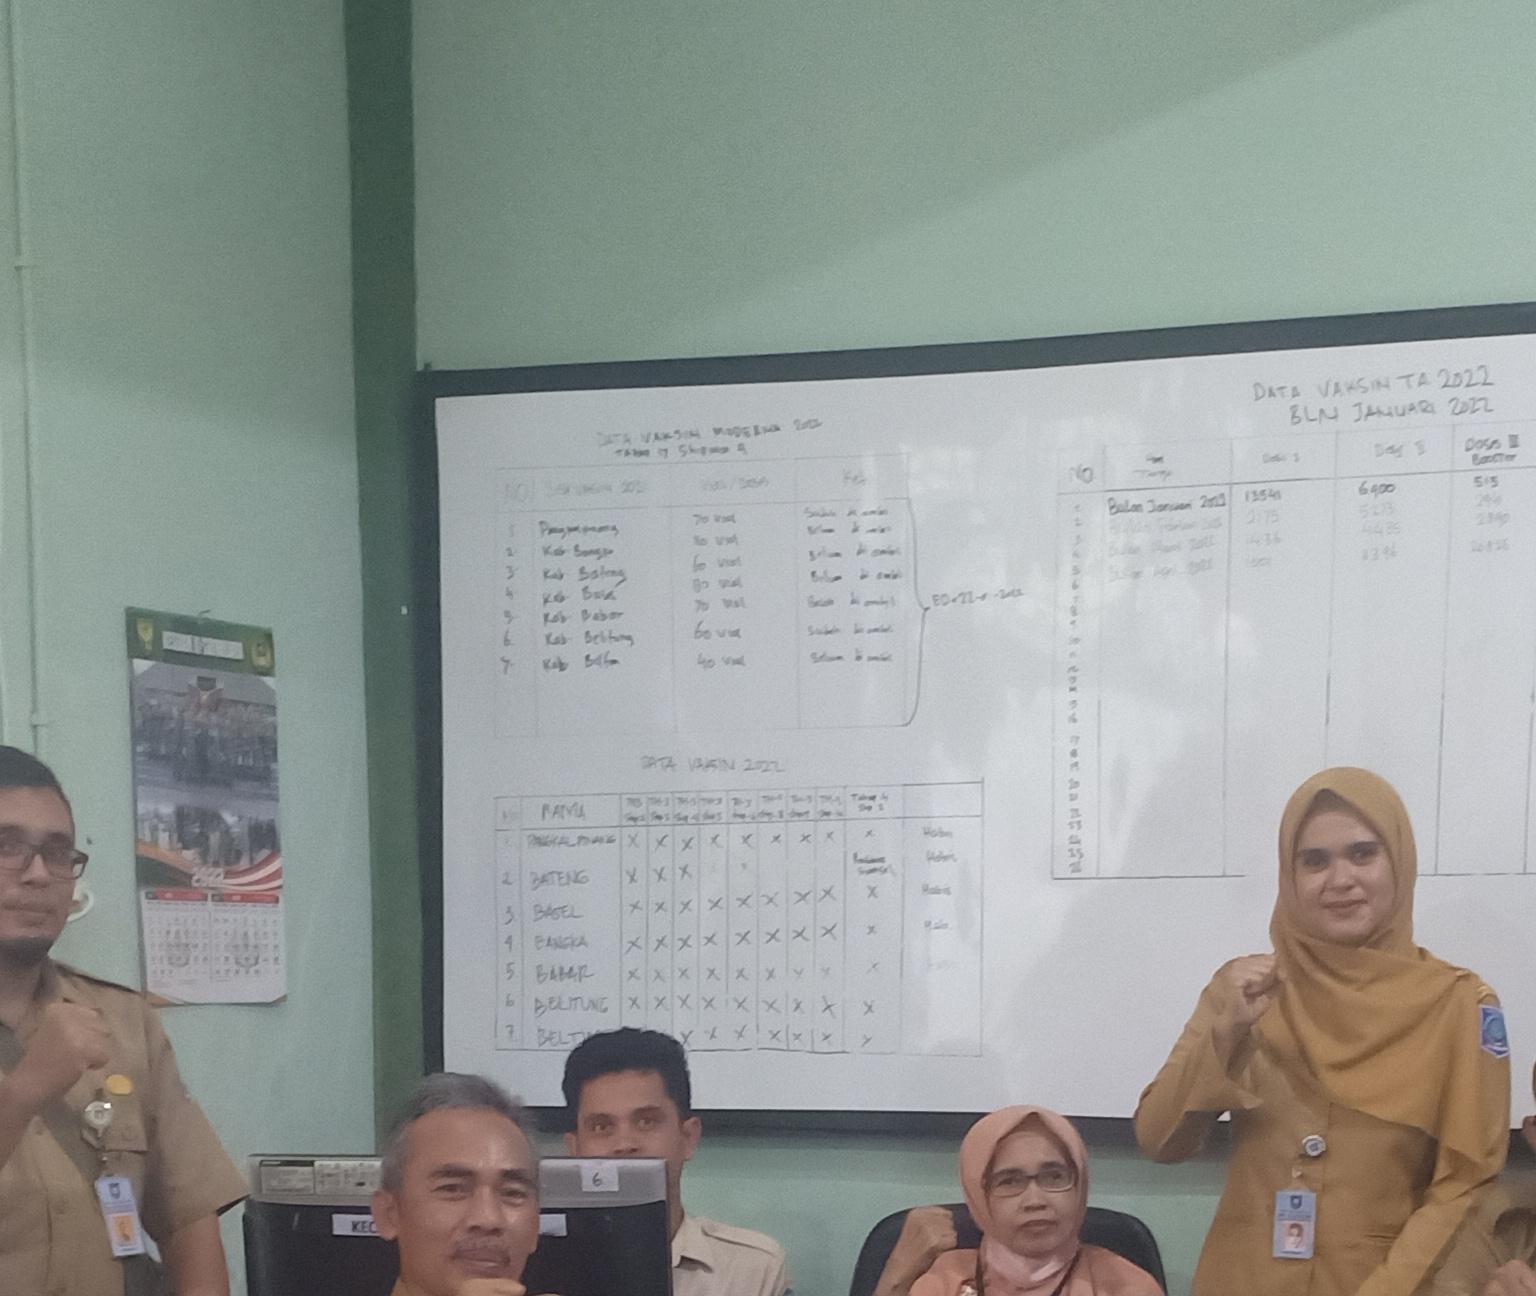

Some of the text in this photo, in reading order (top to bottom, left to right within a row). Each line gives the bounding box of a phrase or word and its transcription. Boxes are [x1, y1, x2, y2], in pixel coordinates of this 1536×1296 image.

[1253, 364, 1495, 400] DATA VAKSIN TA 2022
[1289, 396, 1495, 425] BLN JANUARI 2022
[743, 757, 786, 773] 2022
[592, 1171, 603, 1187] 6
[351, 1219, 377, 1235] KEC
